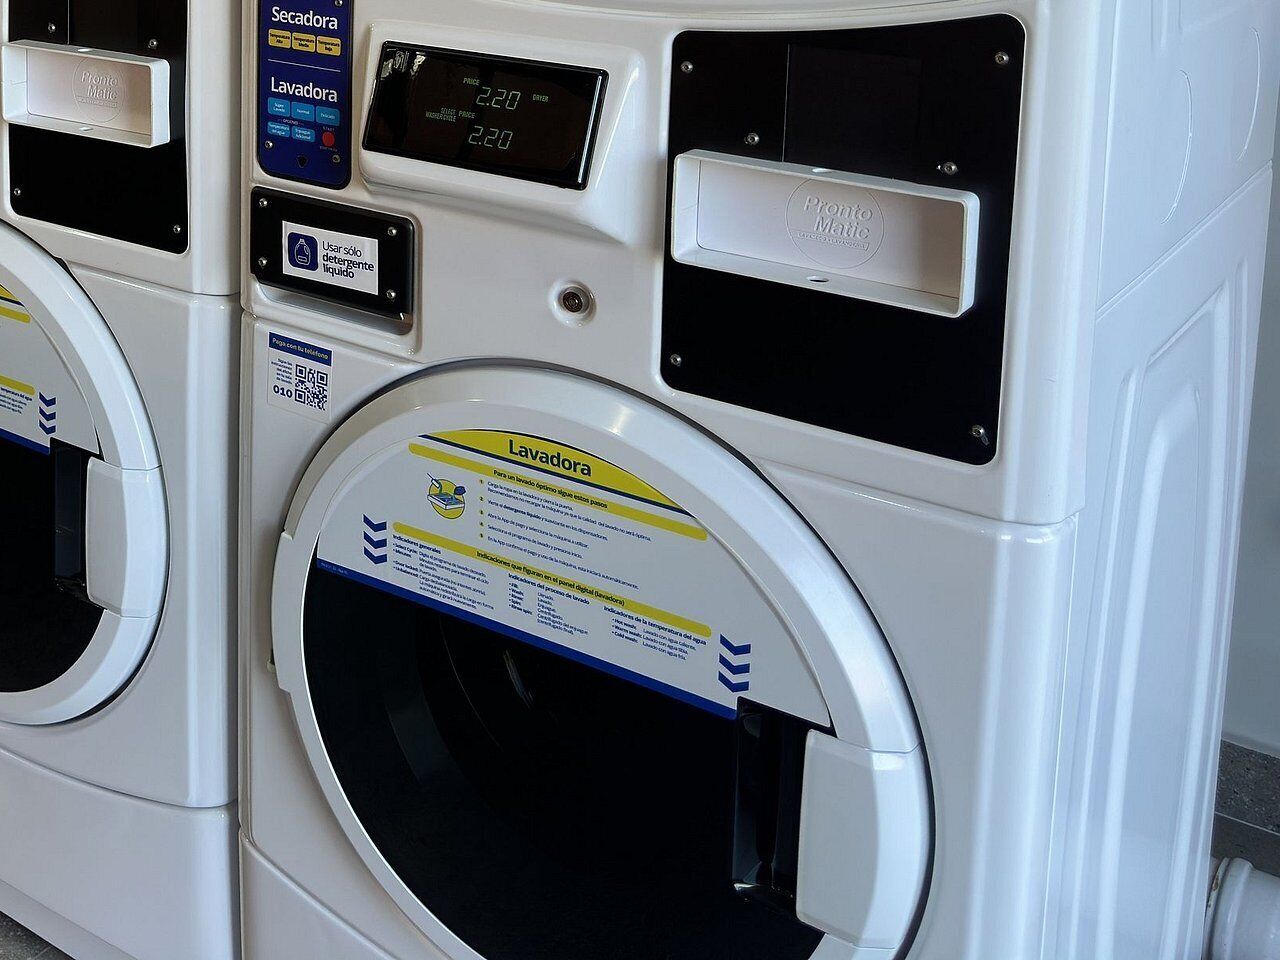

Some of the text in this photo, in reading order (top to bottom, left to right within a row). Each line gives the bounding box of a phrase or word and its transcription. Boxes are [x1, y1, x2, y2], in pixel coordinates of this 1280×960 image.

[271, 6, 338, 30] Secadora
[269, 32, 290, 40] Temperatura
[293, 36, 314, 44] Temperatura
[82, 70, 118, 87] Pronto
[271, 76, 338, 102] Lavadora
[462, 78, 480, 86] PRICE
[88, 84, 117, 100] Matic
[476, 87, 548, 110] 2.20 DRYER
[458, 110, 476, 119] PRICE
[468, 126, 513, 150] 2.20
[803, 194, 874, 222] Pronto
[814, 215, 870, 240] Matic
[322, 240, 362, 258] Usar sólo
[322, 252, 374, 272] detergente
[322, 264, 354, 279] líquido
[272, 338, 286, 346] Paga
[304, 348, 328, 360] teléfono
[273, 384, 292, 398] 010
[508, 439, 592, 477] Lavadora
[494, 469, 608, 510] Para un lavado óptimo sigue estos pasos
[476, 551, 510, 568] Indicaciones
[511, 562, 522, 572] que
[523, 564, 544, 578] figuran
[553, 574, 558, 582] el
[558, 578, 575, 590] panel
[576, 584, 594, 596] digital
[594, 590, 624, 607] (lavadora)
[508, 572, 536, 587] Indicadores
[536, 582, 544, 590] del
[546, 585, 564, 599] proceso
[572, 593, 590, 605] lavado
[604, 606, 634, 621] Indicadores
[634, 616, 642, 624] de
[648, 620, 682, 638] temperatura
[683, 630, 692, 640] del
[692, 634, 706, 646] agua
